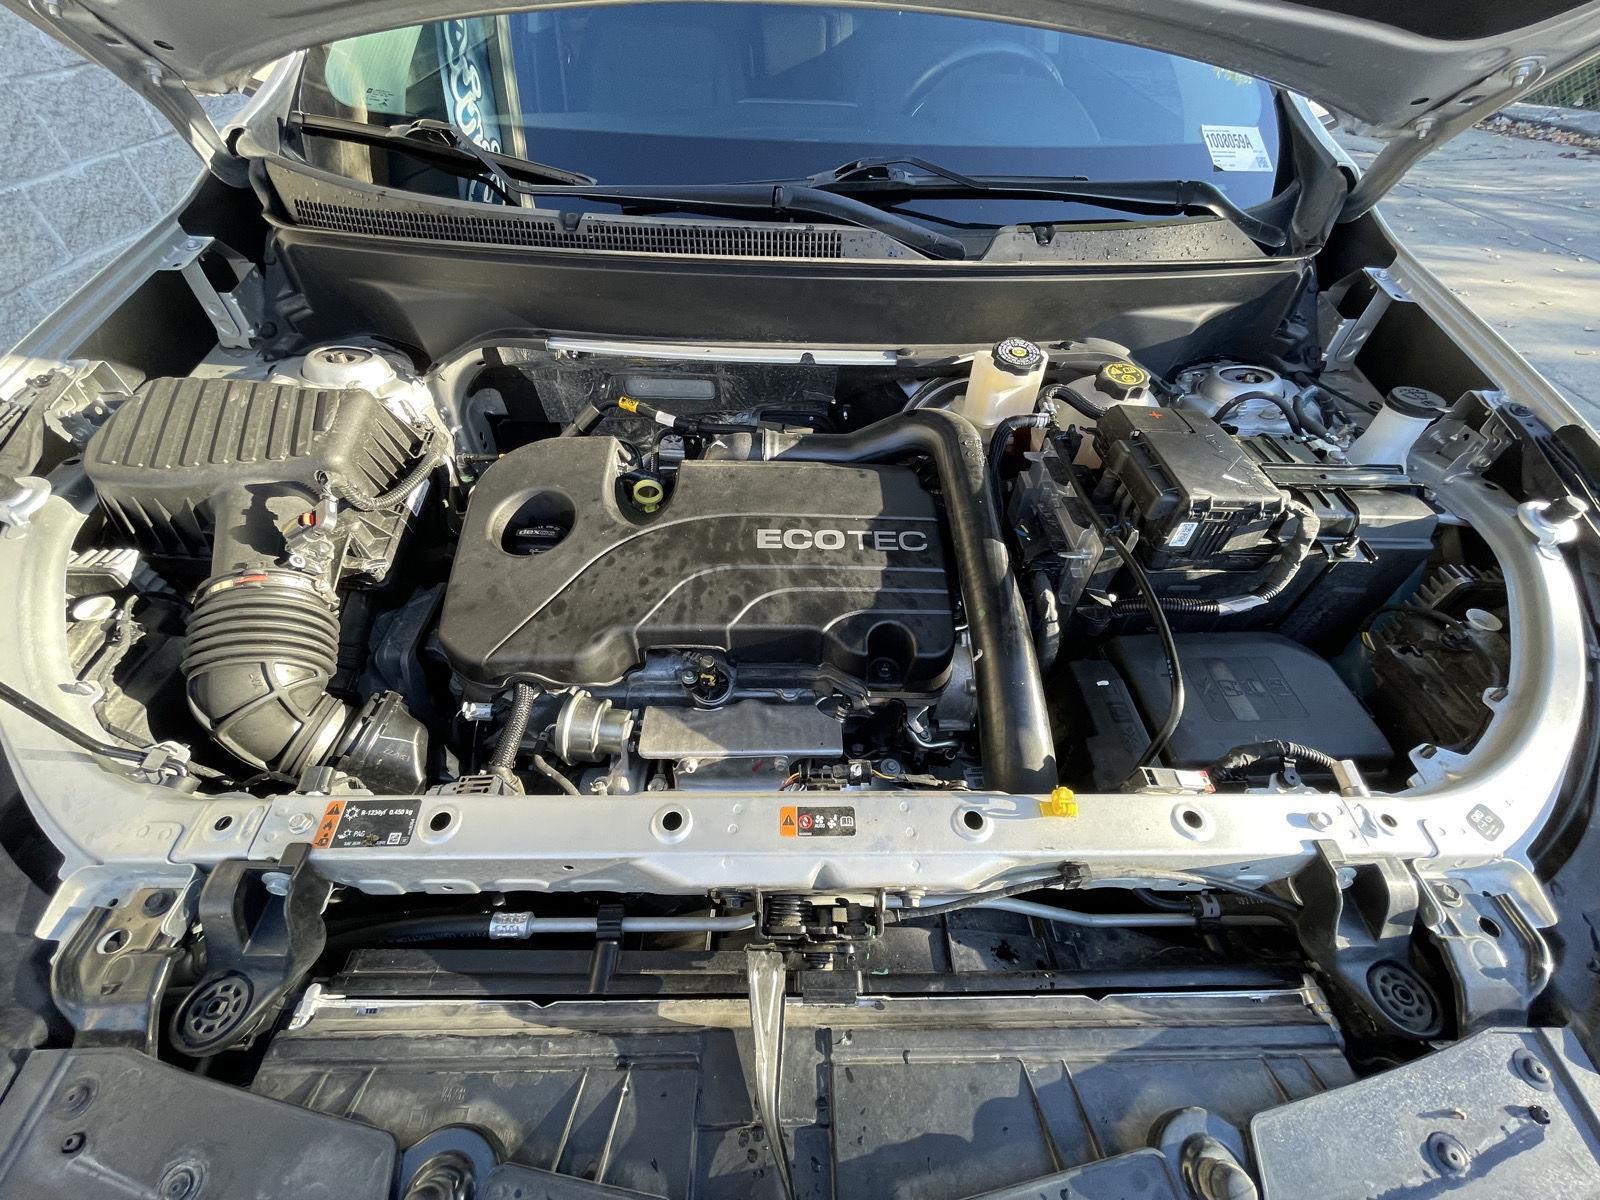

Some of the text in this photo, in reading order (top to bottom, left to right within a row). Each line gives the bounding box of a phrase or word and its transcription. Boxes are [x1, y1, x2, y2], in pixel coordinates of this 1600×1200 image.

[1206, 133, 1253, 149] 1008059A
[756, 529, 928, 551] ECOTEC
[353, 830, 366, 838] PAG
